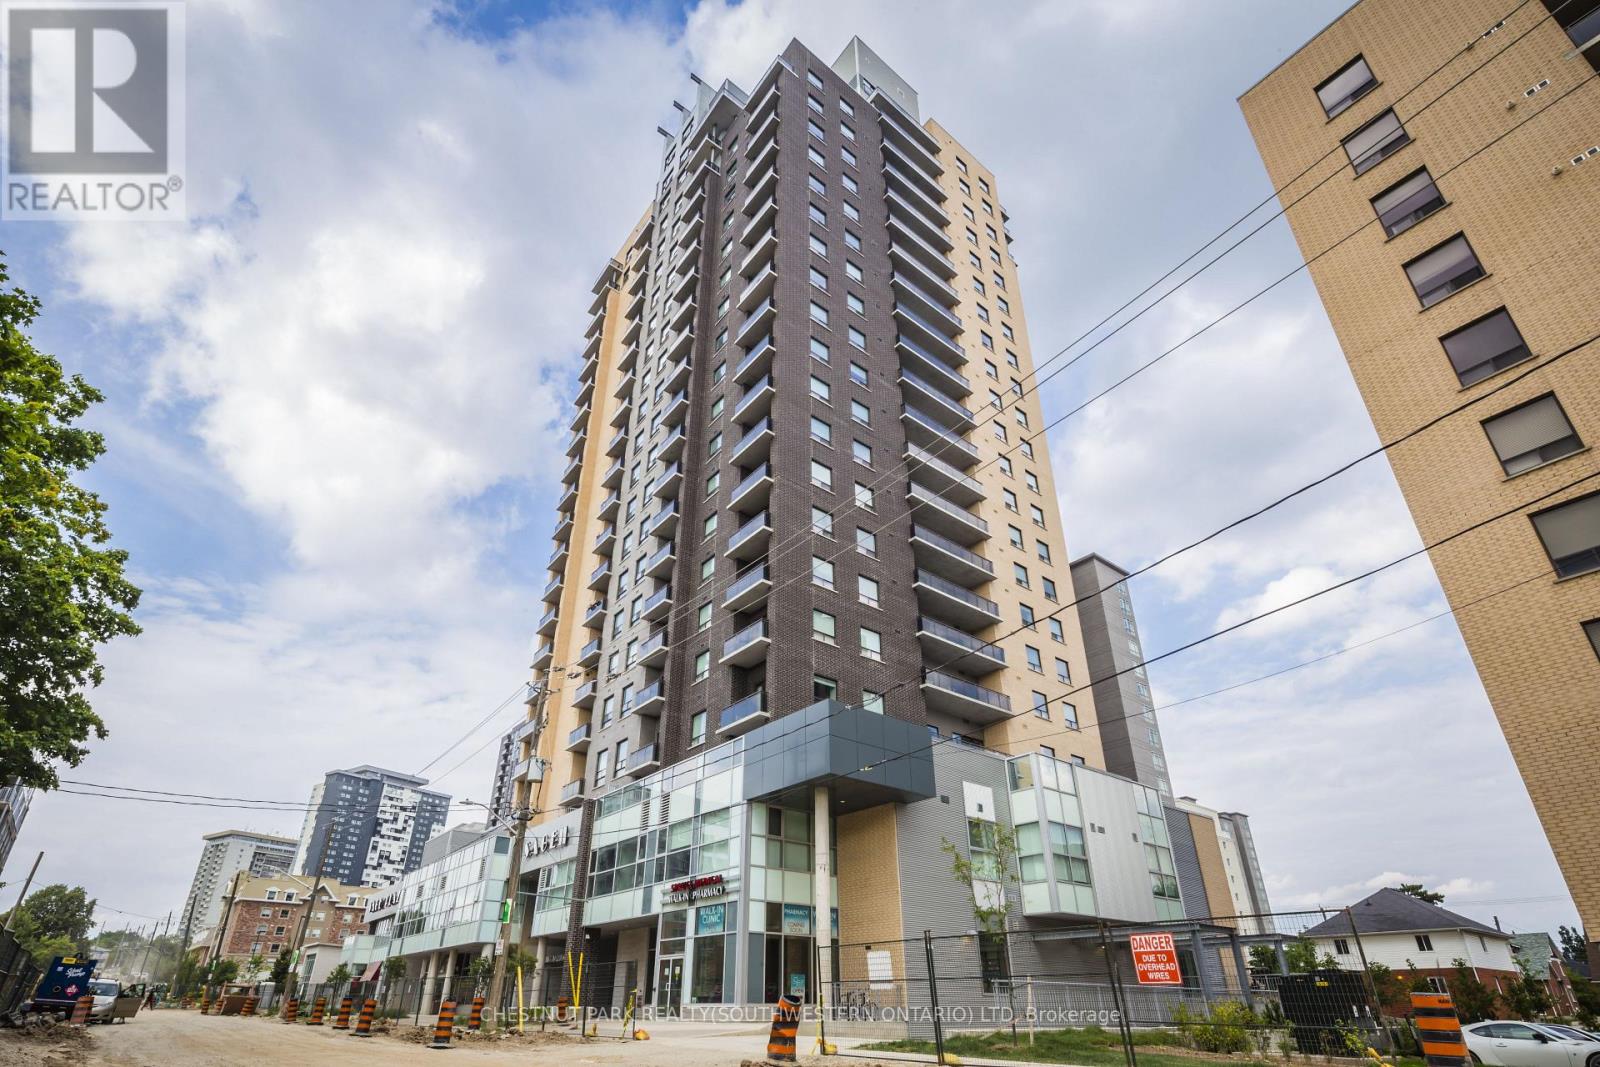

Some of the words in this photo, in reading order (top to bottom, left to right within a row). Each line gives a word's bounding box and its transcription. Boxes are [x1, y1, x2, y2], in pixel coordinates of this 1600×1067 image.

[692, 886, 723, 900] PHARMACY
[700, 905, 724, 917] WALK-IN
[702, 914, 721, 925] CLINIC
[1131, 936, 1173, 950] DANGER
[1142, 954, 1156, 962] DUE
[1156, 954, 1167, 962] TO
[1138, 963, 1176, 971] OVERHEAD
[1147, 972, 1170, 980] WIRES
